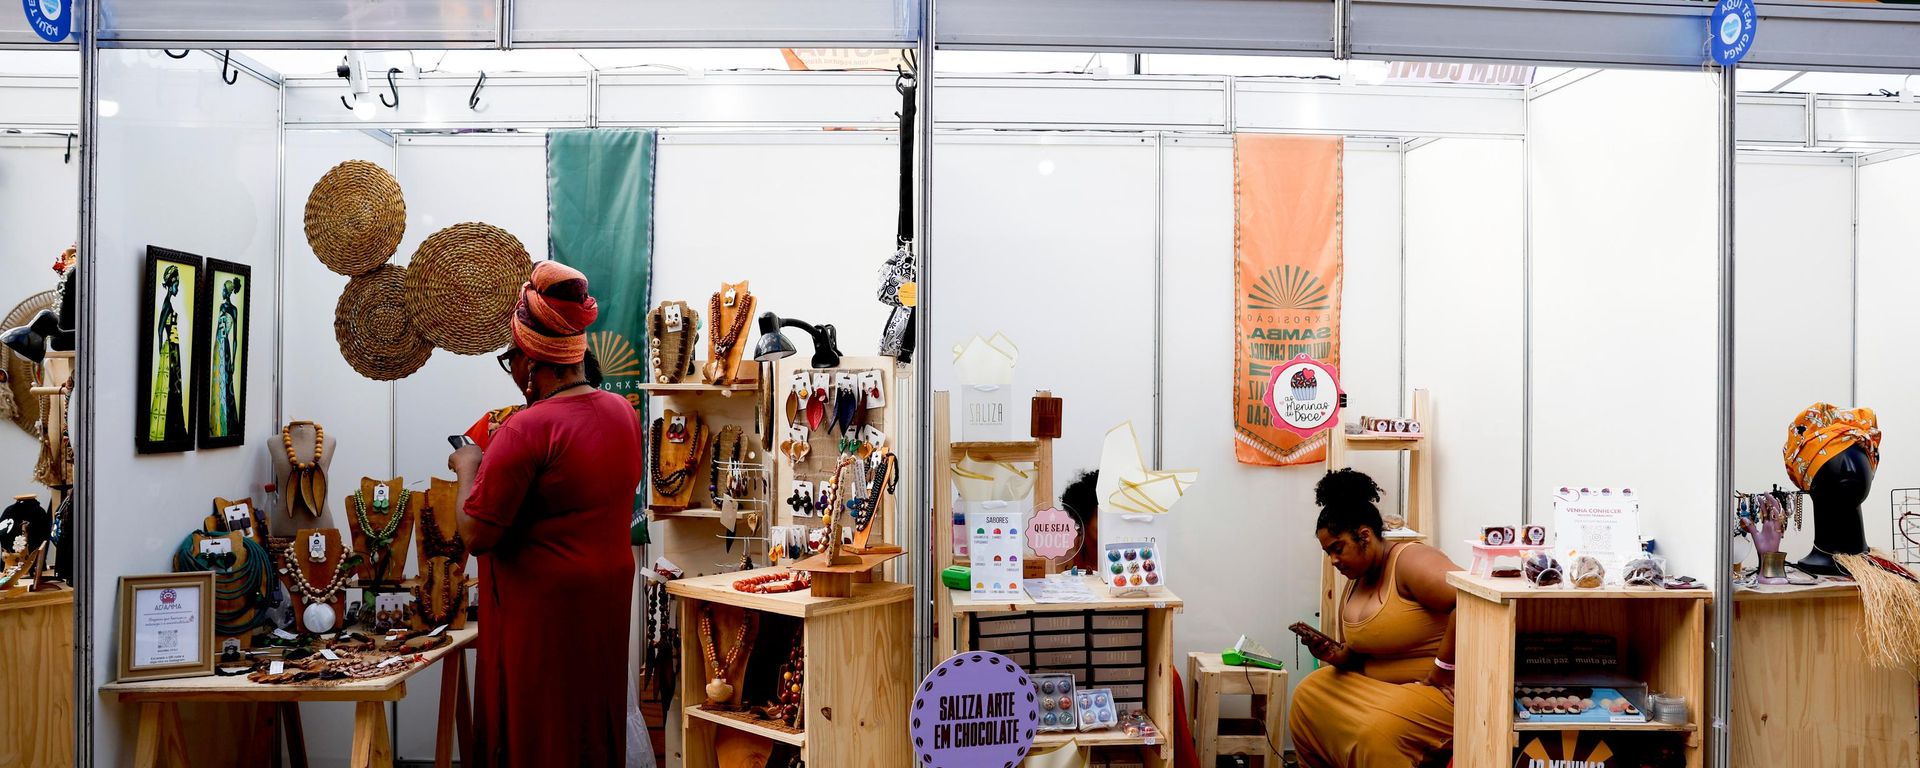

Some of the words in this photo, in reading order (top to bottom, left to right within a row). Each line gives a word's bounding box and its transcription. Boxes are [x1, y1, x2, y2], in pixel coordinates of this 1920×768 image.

[28, 0, 38, 17] TE
[1721, 0, 1742, 14] AQUI
[1742, 3, 1752, 30] TEM
[36, 17, 58, 36] AQUI
[1724, 33, 1750, 60] GINGA
[969, 403, 1003, 423] SALIZA
[1294, 410, 1322, 422] Doce
[986, 516, 1009, 524] SABORES
[1034, 523, 1049, 533] QUE
[1051, 523, 1070, 533] SEJA
[1034, 533, 1070, 548] DOCE
[1526, 656, 1551, 664] muita
[1602, 658, 1617, 666] paz
[939, 694, 983, 721] SALIZA
[986, 692, 1015, 718] ARTE
[934, 723, 951, 750] EM
[954, 719, 1019, 748] CHOCOLATE
